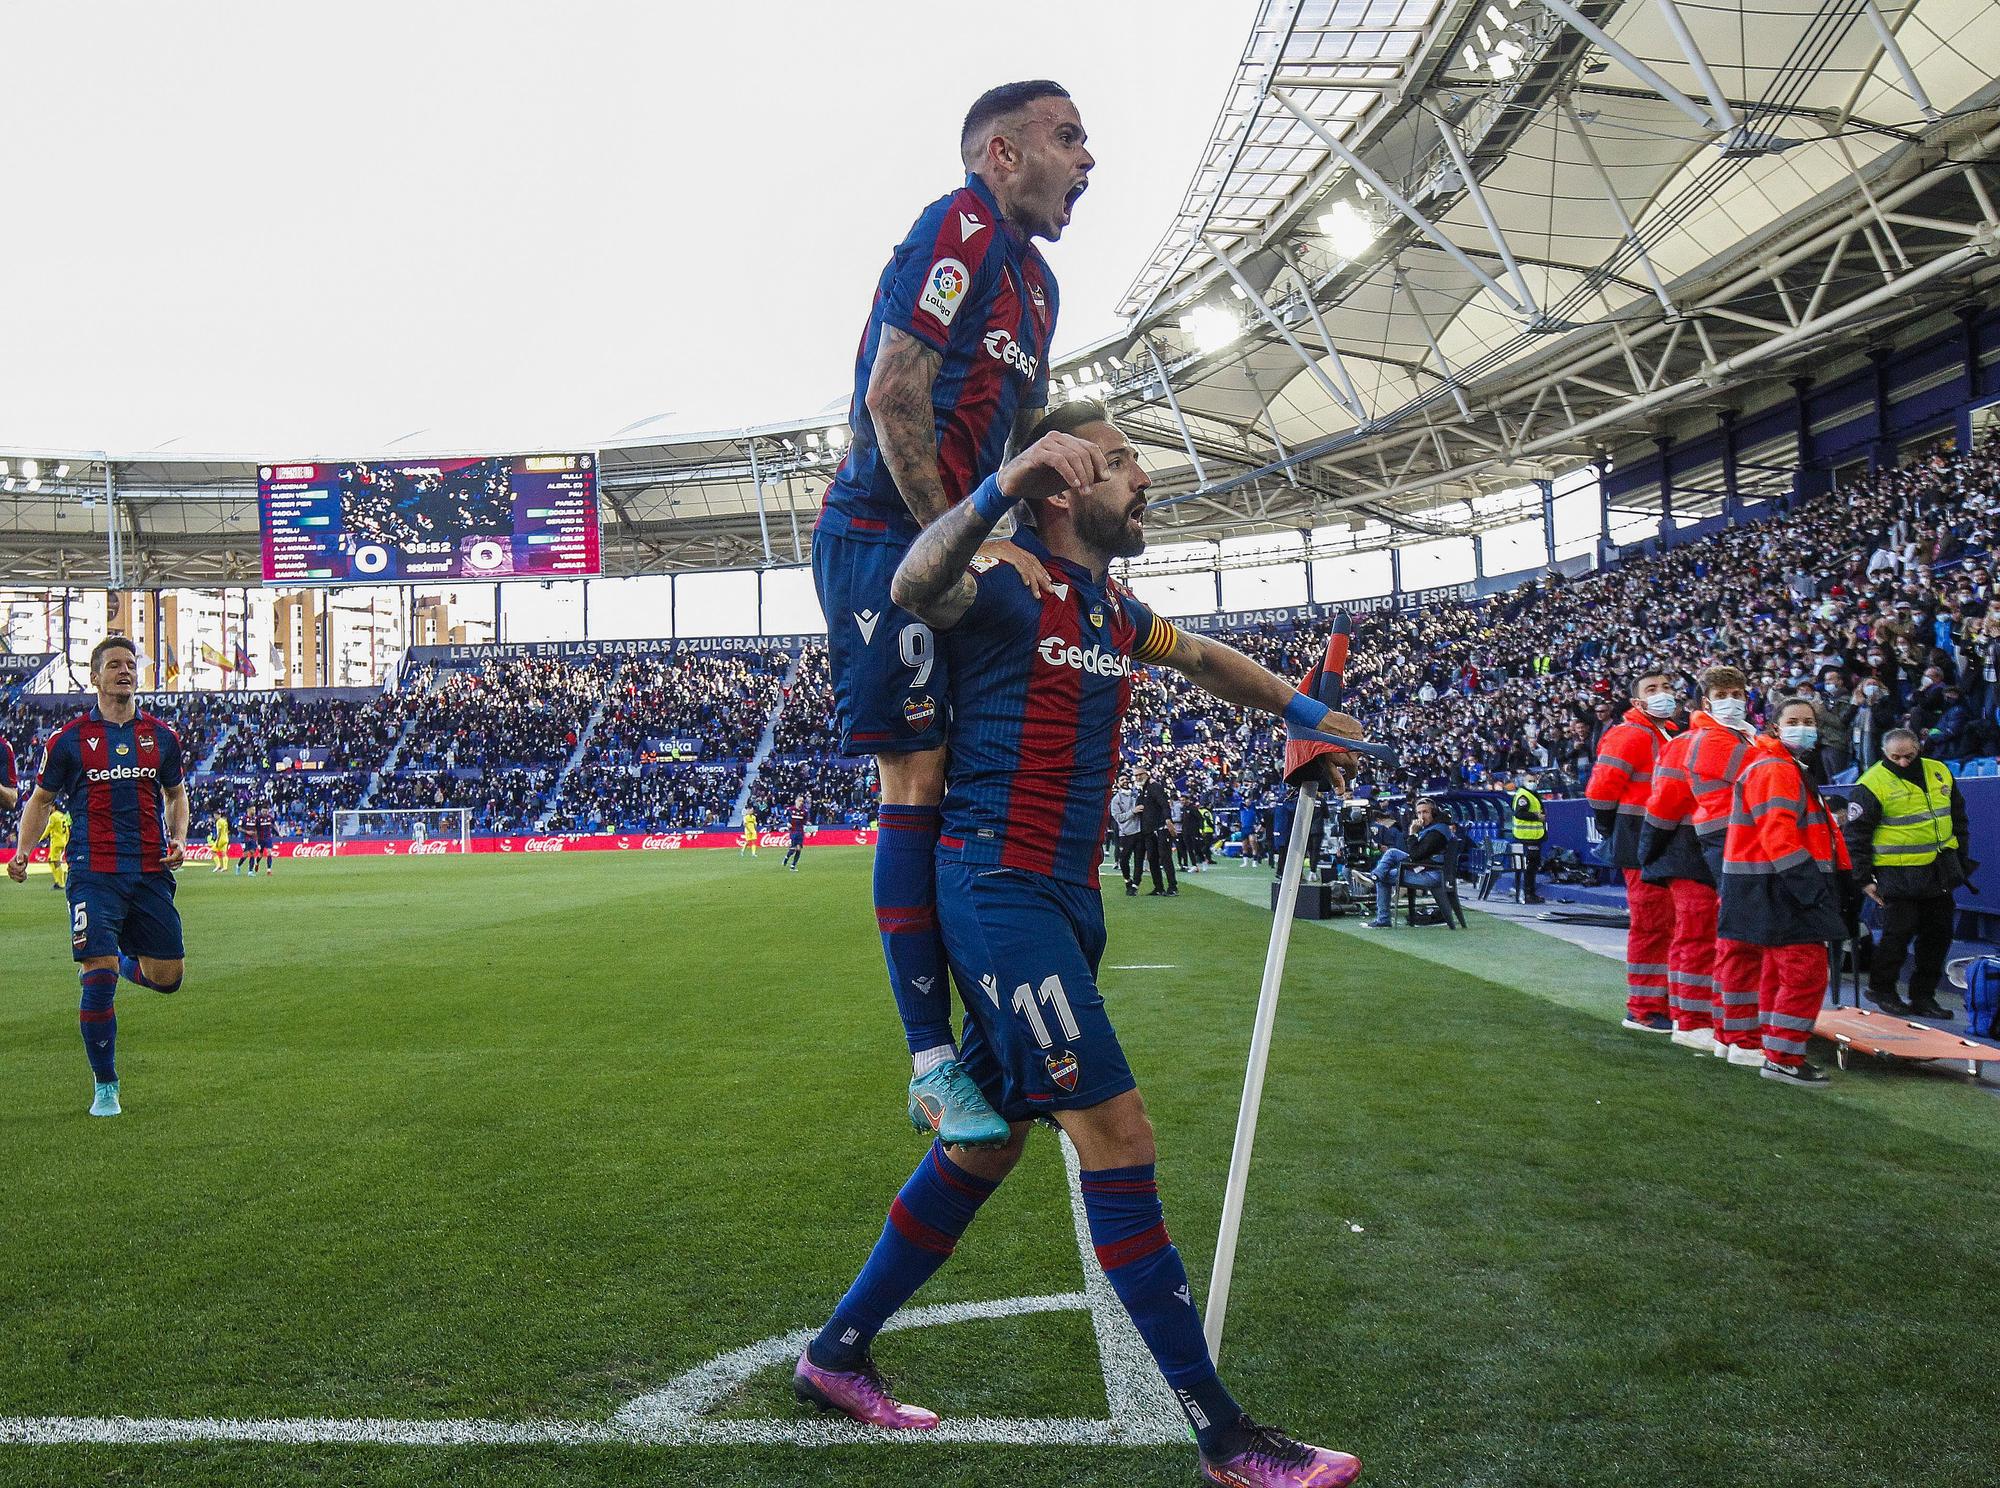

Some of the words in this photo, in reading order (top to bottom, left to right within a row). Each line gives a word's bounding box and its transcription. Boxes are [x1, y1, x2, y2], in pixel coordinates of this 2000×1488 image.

[926, 294, 950, 317] LaLiga
[355, 546, 388, 573] 0
[471, 542, 503, 570] 0
[1216, 614, 1238, 628] TU
[1244, 609, 1289, 624] PASO
[1298, 606, 1317, 620] EL
[1397, 594, 1416, 608] TE
[1422, 582, 1477, 605] ESPERA
[536, 644, 558, 656] EN
[566, 642, 597, 655] LAS
[602, 640, 671, 654] BARRAS
[677, 636, 792, 651] AZULGRANAS
[899, 622, 934, 688] 9
[86, 765, 156, 781] Gedesco
[73, 902, 88, 931] 5
[1011, 974, 1081, 1049] 11
